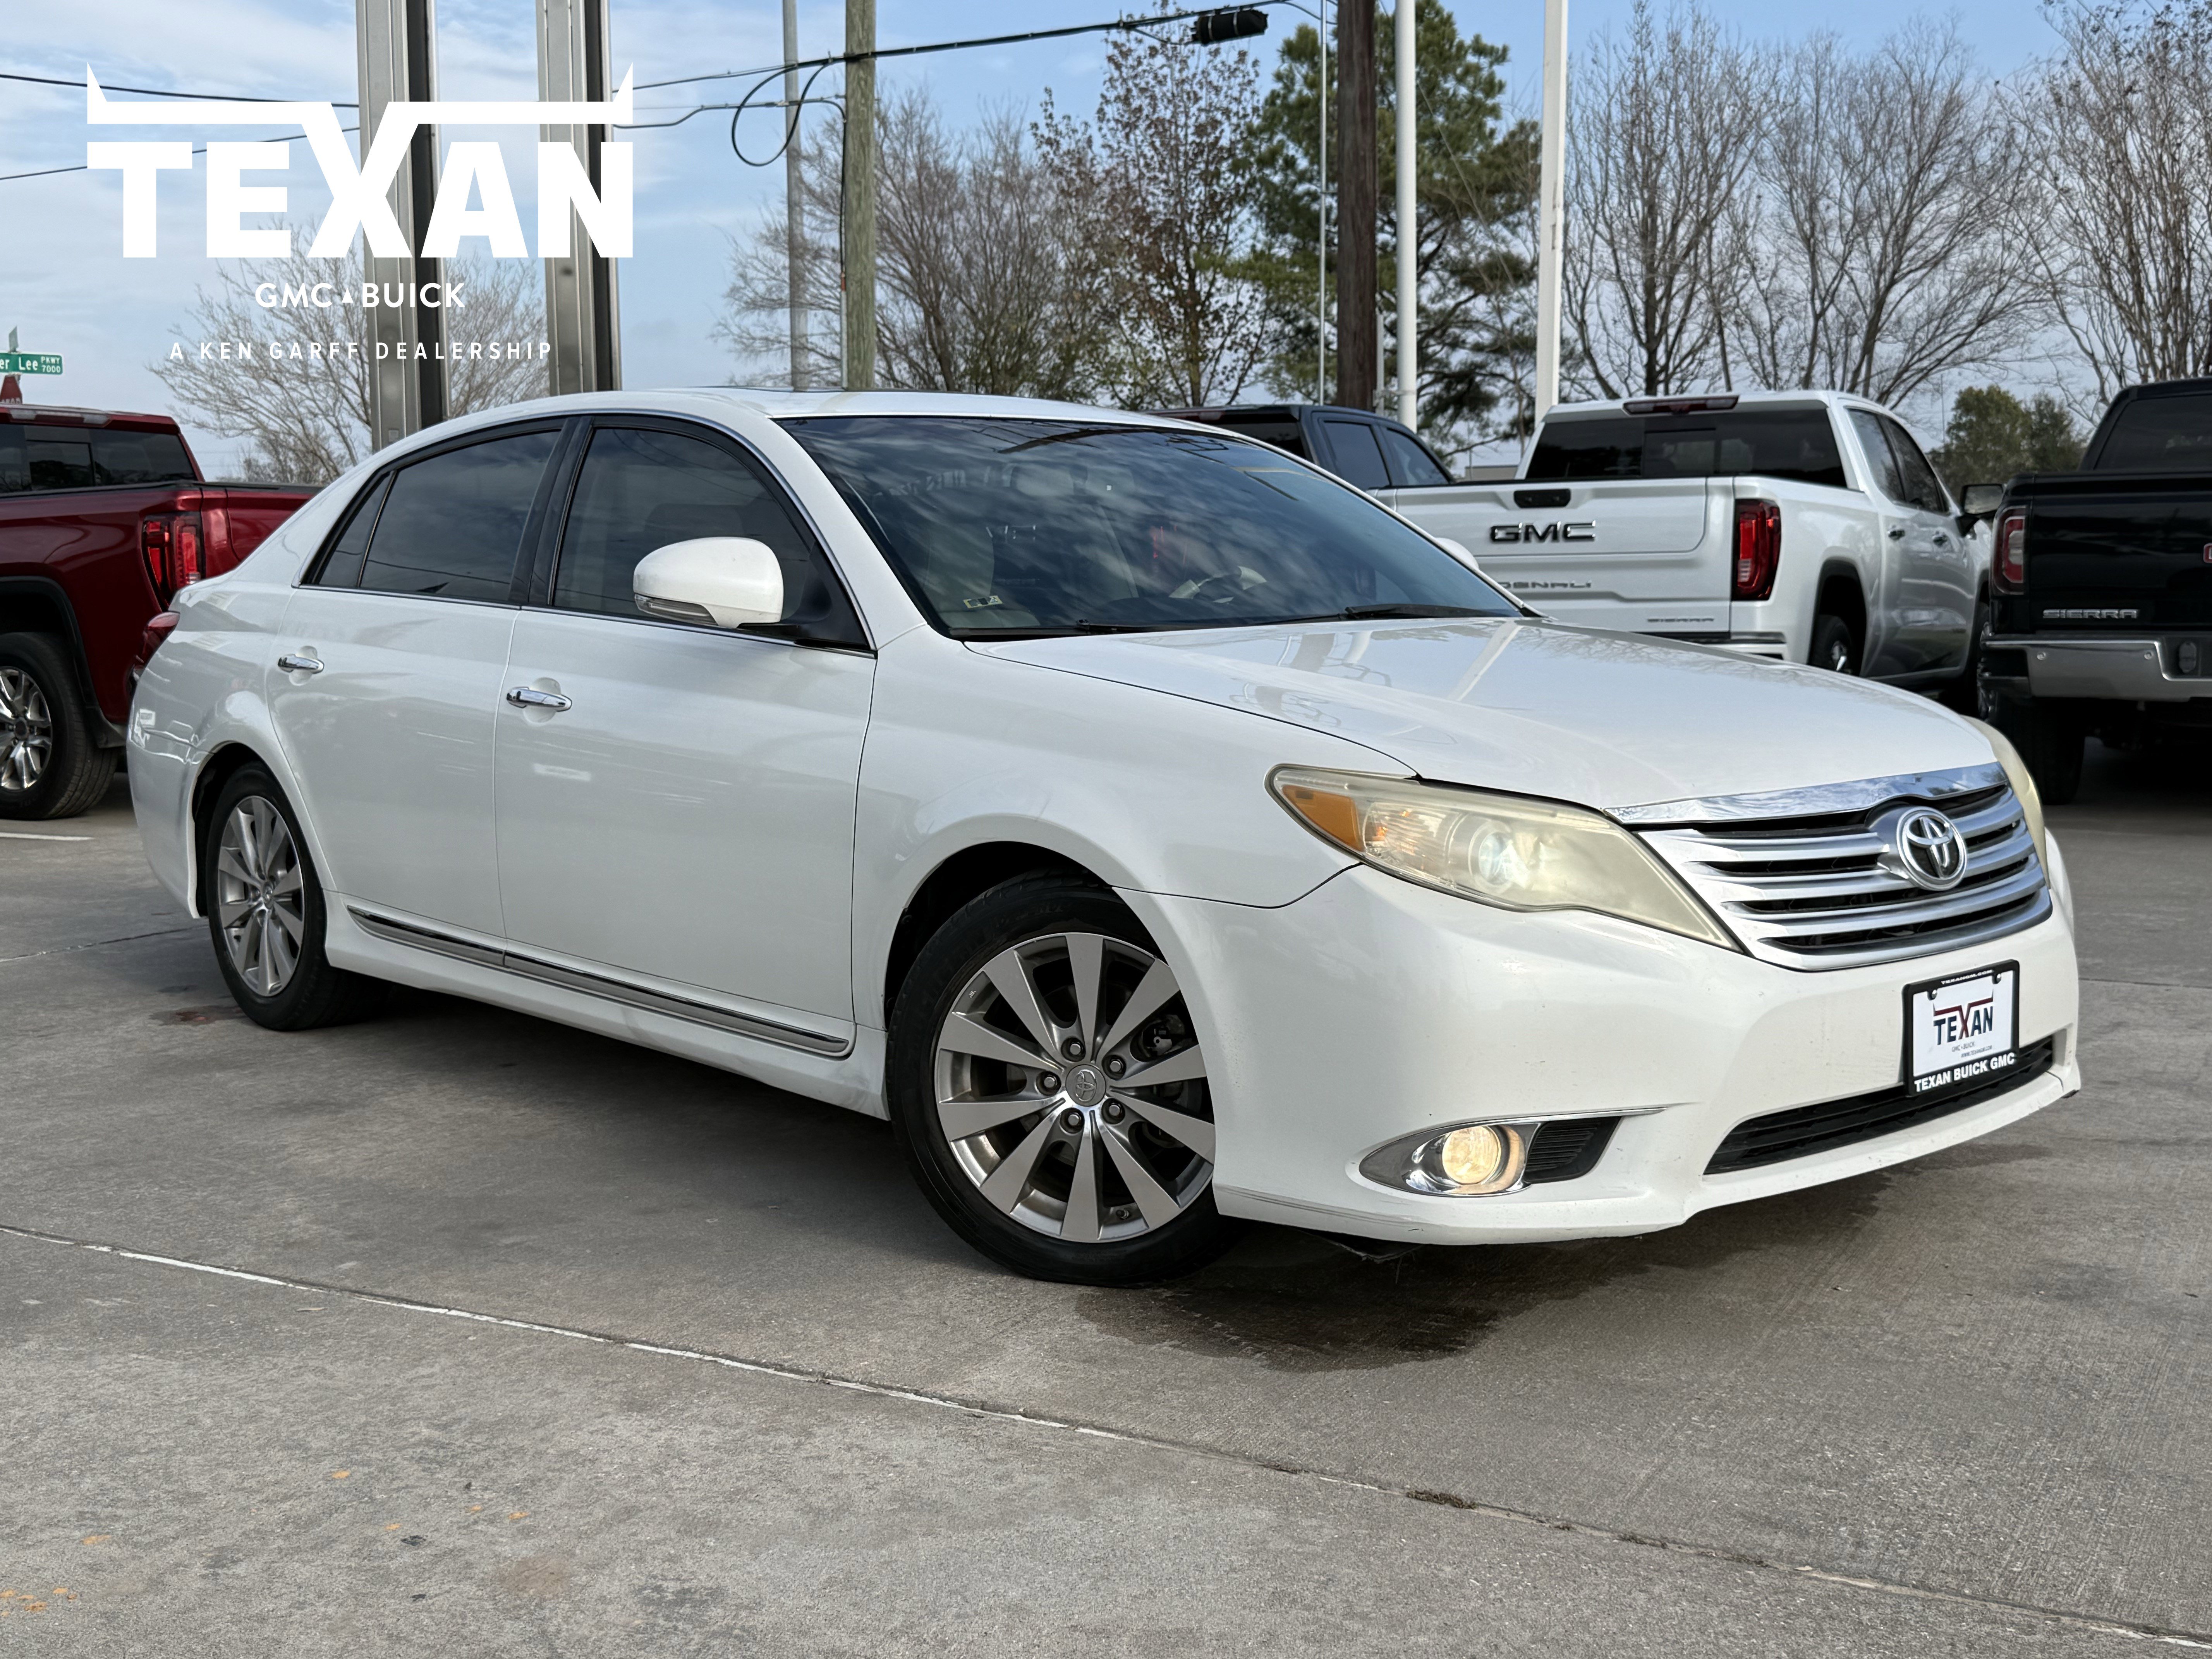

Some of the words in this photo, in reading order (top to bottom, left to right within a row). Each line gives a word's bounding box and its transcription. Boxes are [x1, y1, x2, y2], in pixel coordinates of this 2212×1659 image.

[19, 356, 38, 371] Lee
[41, 356, 60, 364] PKWY
[41, 365, 61, 373] 7000
[1491, 520, 1596, 542] GMC
[2043, 609, 2137, 619] SIERRA
[1933, 989, 1994, 1045] TEXAN
[1914, 1070, 1951, 1092] TEXAN
[1954, 1060, 1989, 1081] BUICK
[1990, 1052, 2015, 1070] GMC
